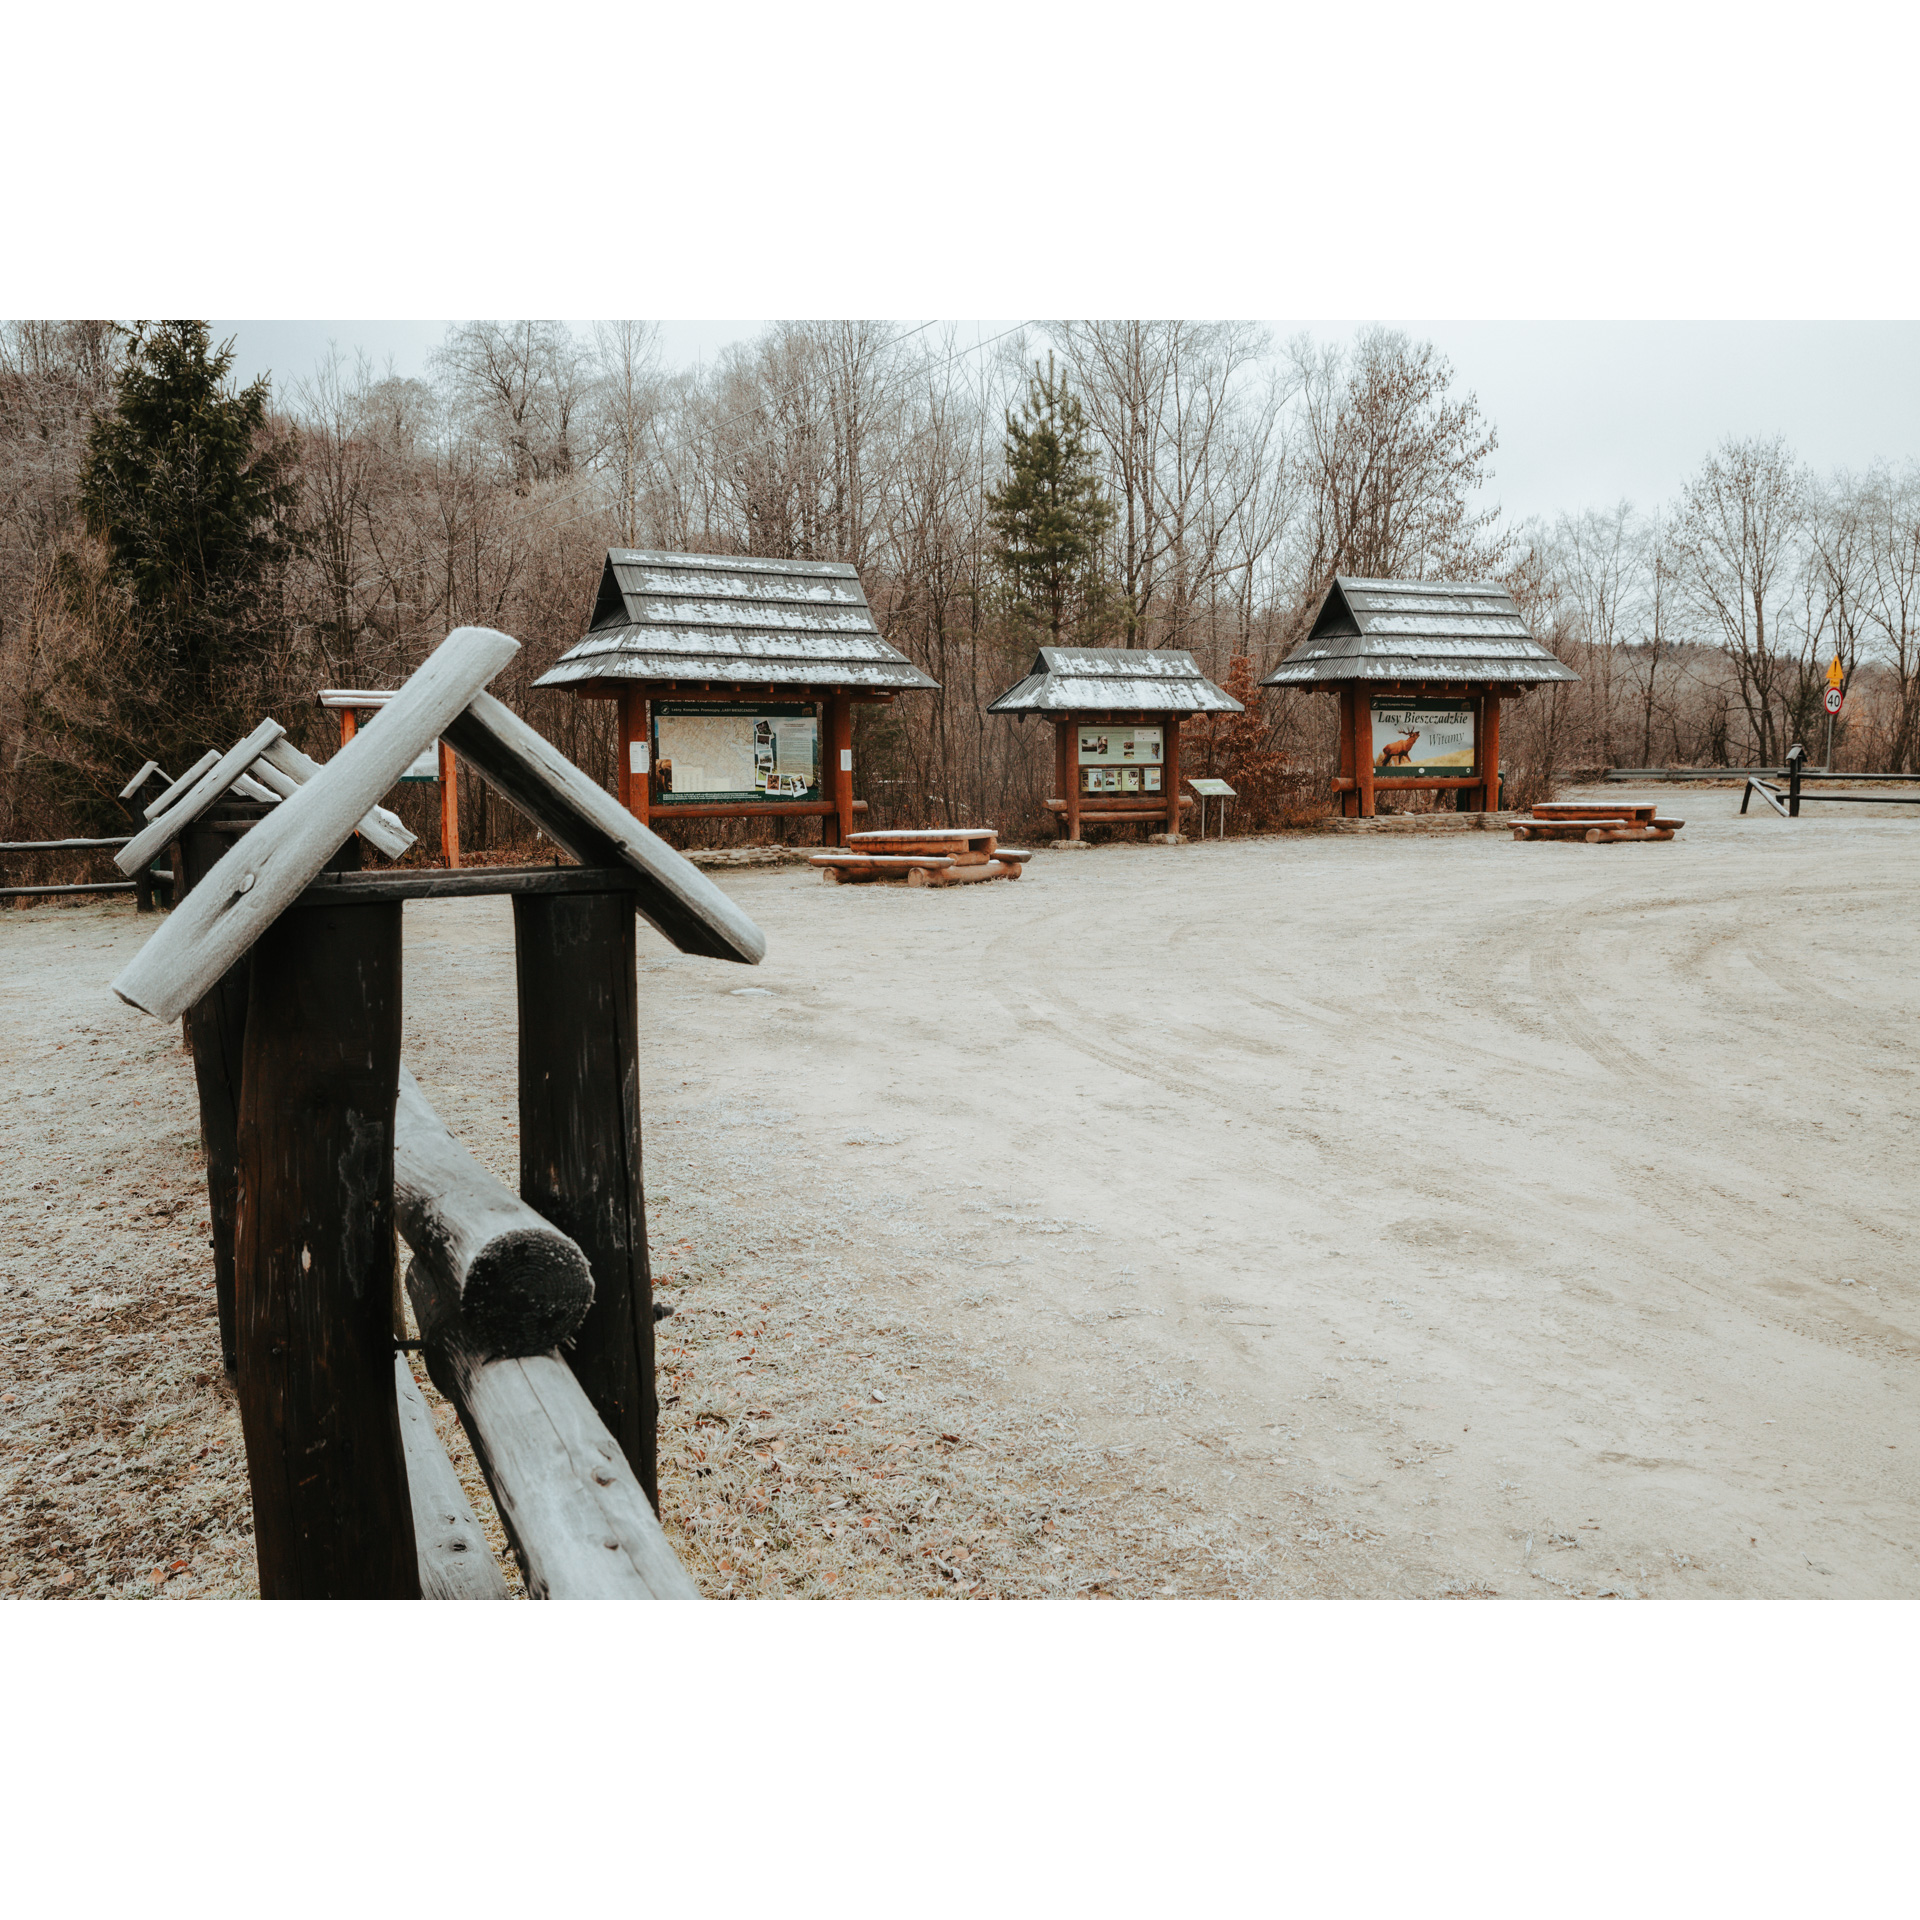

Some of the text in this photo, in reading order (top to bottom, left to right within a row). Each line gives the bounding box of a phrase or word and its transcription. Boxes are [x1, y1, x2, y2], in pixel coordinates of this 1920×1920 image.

[1827, 694, 1840, 707] 40
[1378, 711, 1468, 726] Lasy Bieszczadzkie
[1429, 732, 1465, 747] Witamy
